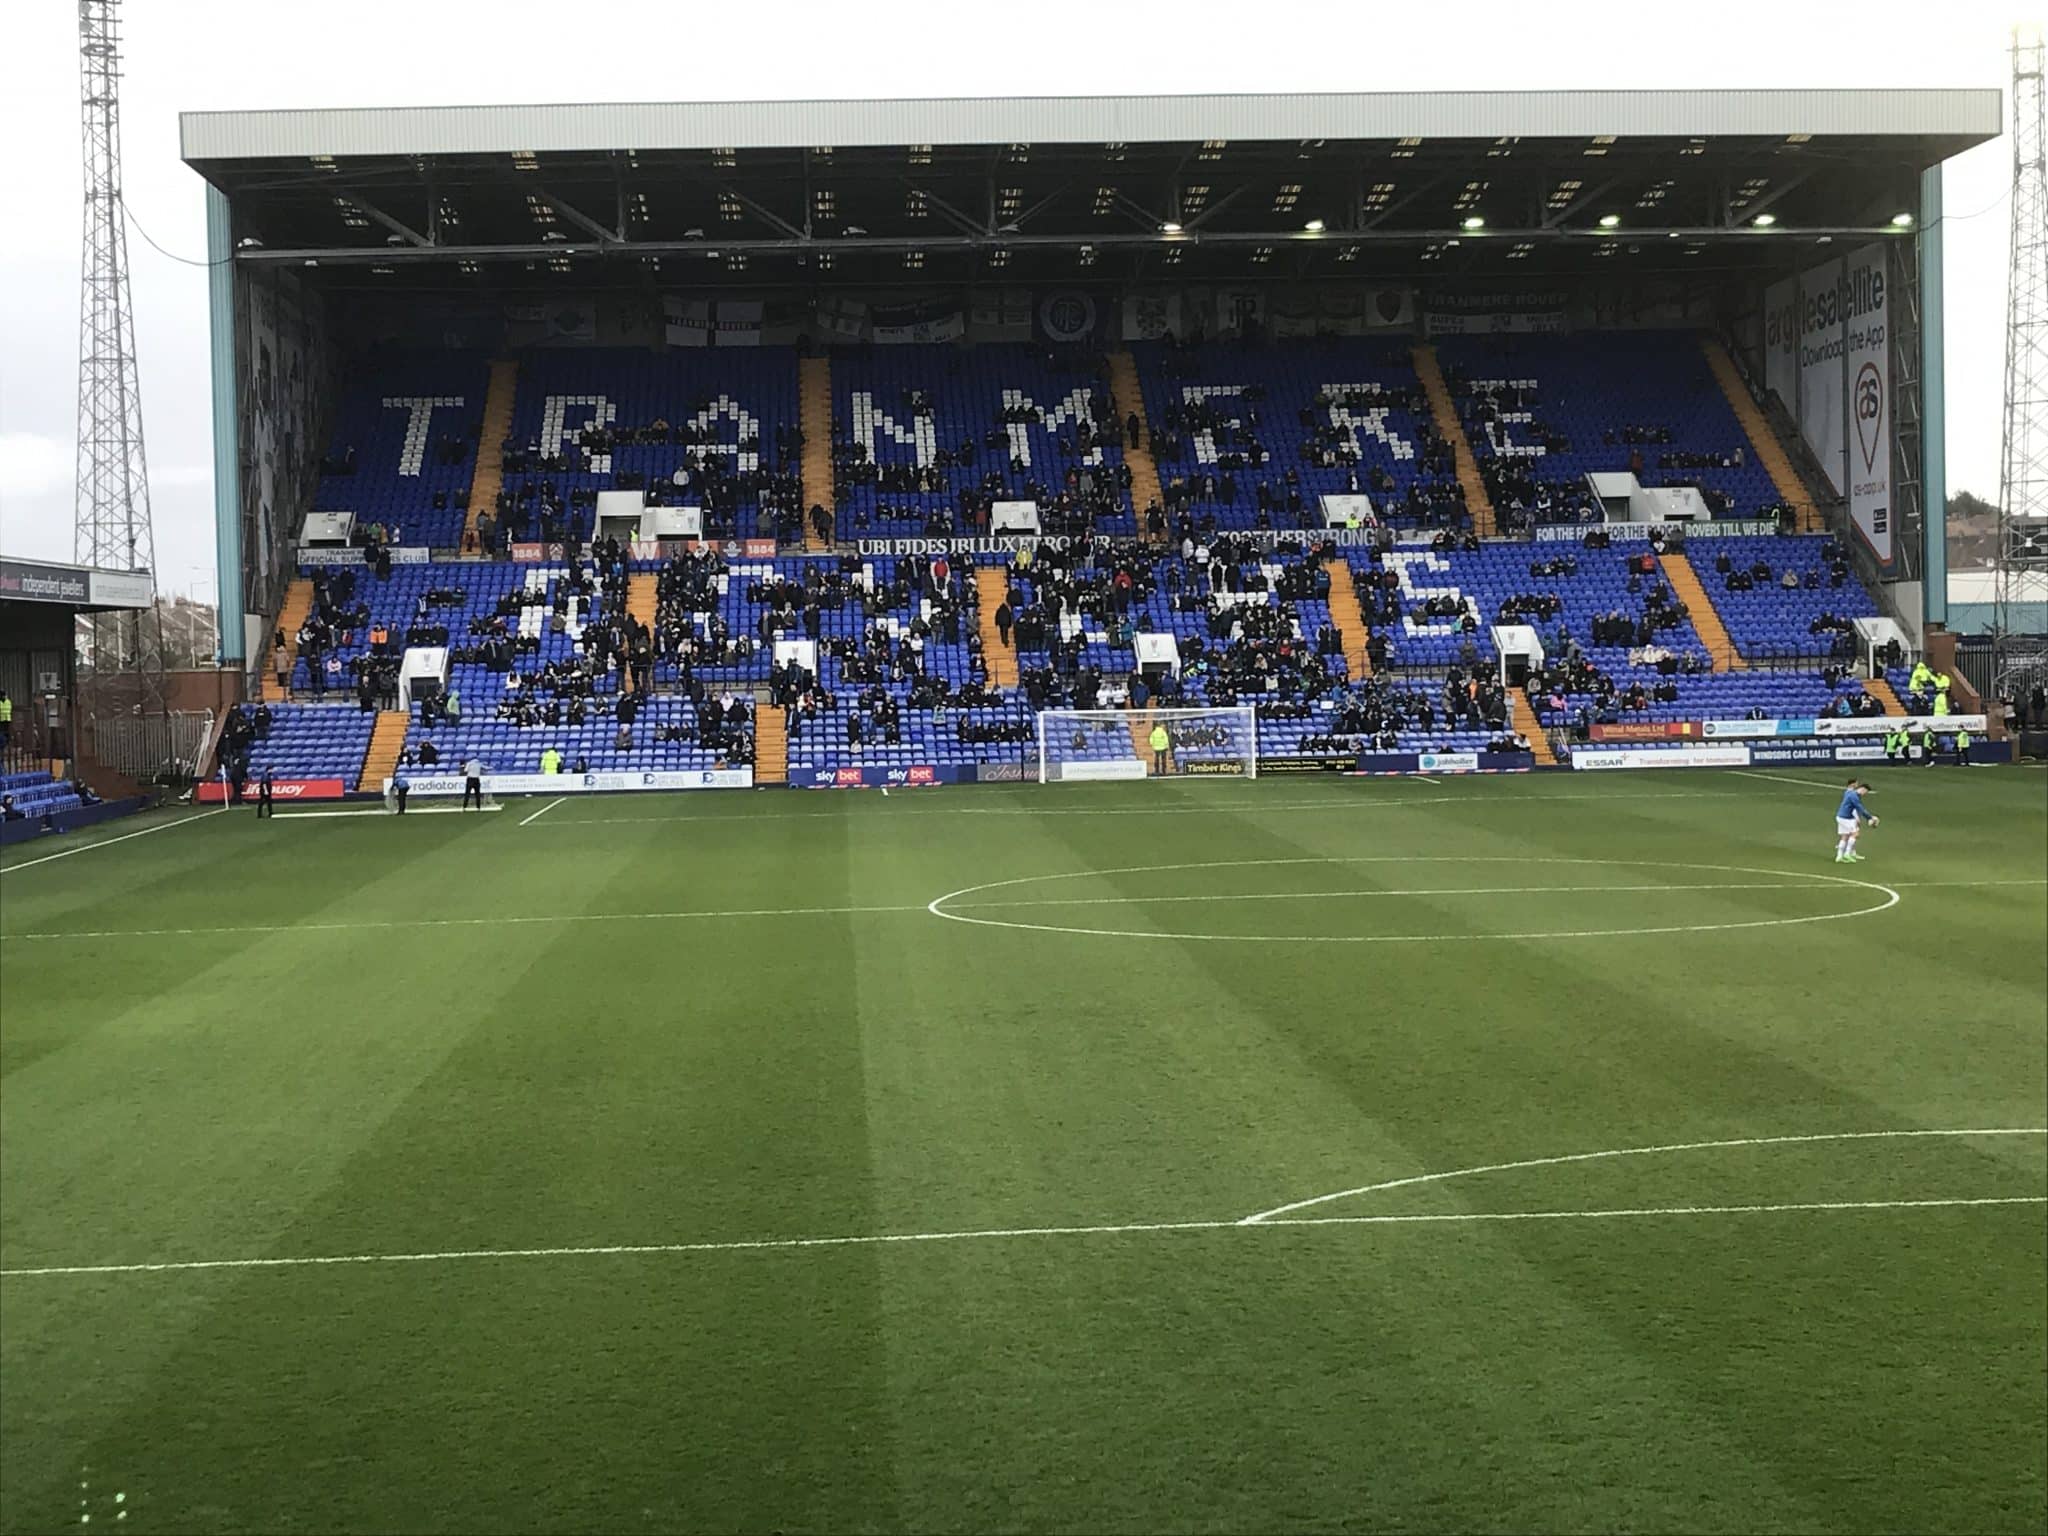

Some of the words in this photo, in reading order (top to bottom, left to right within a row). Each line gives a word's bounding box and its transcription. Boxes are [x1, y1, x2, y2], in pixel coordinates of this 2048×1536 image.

[1535, 528, 1556, 542] FOR
[1556, 527, 1576, 541] THE
[1606, 525, 1625, 539] FOR
[1625, 525, 1648, 539] THE
[1685, 524, 1720, 537] ROVERS
[1721, 523, 1740, 536] TILL
[1742, 522, 1758, 536] WE
[1759, 522, 1775, 535] DIE
[857, 538, 892, 555] UBI
[978, 536, 1018, 553] LUX
[403, 554, 427, 563] CLUB
[1754, 751, 1792, 760] WINDSORS
[1793, 751, 1809, 759] CAR
[1811, 750, 1831, 759] SALES
[1187, 763, 1218, 773] Timber
[1219, 762, 1242, 775] Kings
[1586, 759, 1623, 767] ESSAR
[815, 770, 836, 782] sky
[838, 769, 859, 781] bet
[888, 769, 908, 781] sky
[910, 768, 931, 779] bet
